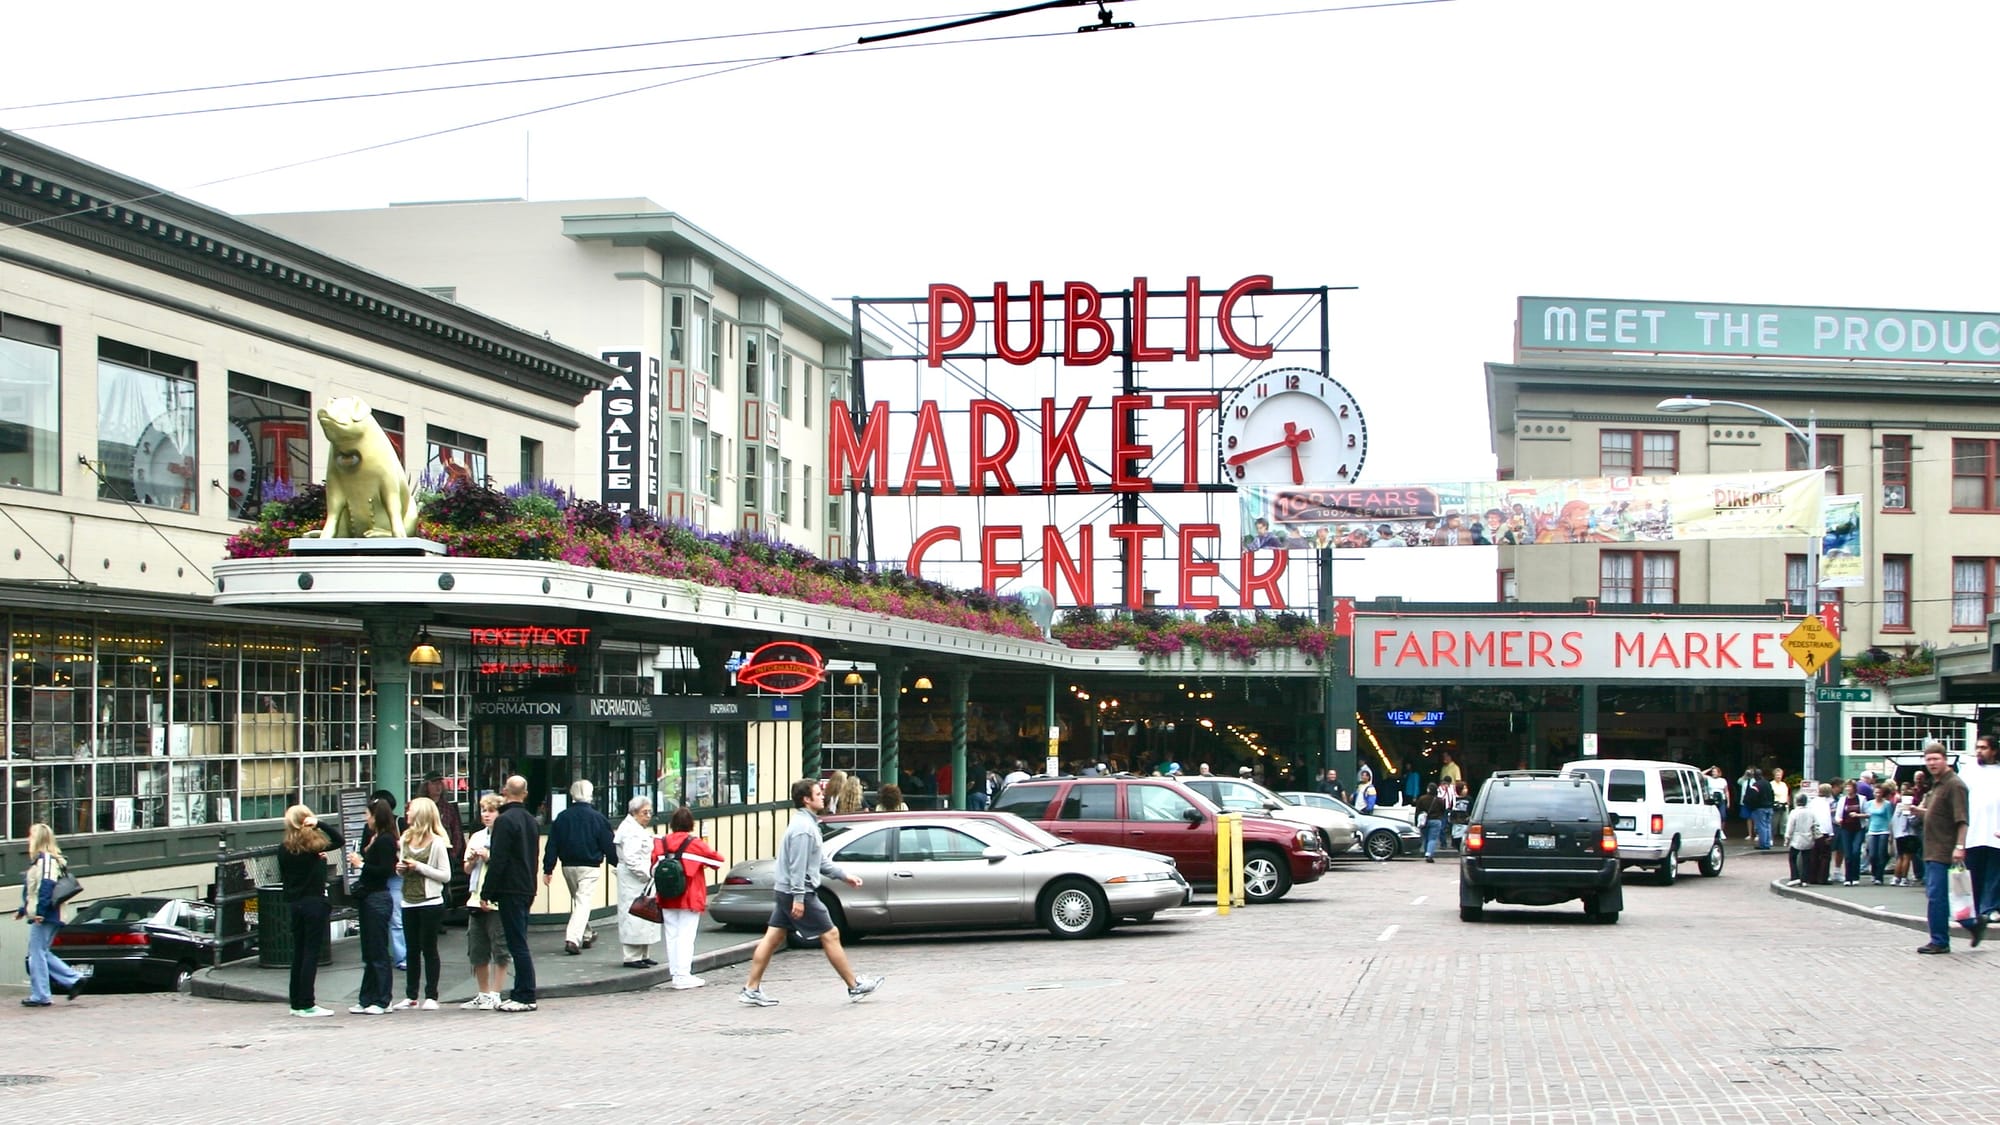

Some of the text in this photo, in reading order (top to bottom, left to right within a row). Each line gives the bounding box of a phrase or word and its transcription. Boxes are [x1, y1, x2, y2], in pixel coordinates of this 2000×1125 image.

[928, 274, 1274, 368] PUBLIC
[1543, 305, 2000, 357] MEET THE PRODUC
[1285, 375, 1300, 390] 12
[1320, 382, 1325, 397] 1
[1257, 383, 1268, 398] 11
[1235, 405, 1249, 420] 10
[1339, 404, 1349, 418] 2
[606, 398, 634, 490] SALLE
[828, 395, 1220, 497] MARKET
[1227, 435, 1238, 449] 9
[1347, 433, 1356, 448] 3
[1235, 465, 1246, 479] 8
[1336, 463, 1349, 478] 4
[1330, 490, 1420, 508] YEARS
[1714, 488, 1750, 508] PIKE
[905, 523, 1290, 611] CENTER
[1801, 624, 1822, 632] YIELD
[1807, 632, 1816, 640] TO
[1372, 629, 1585, 669] FARMERS
[1788, 640, 1834, 649] PEDESTRIANS
[1820, 688, 1842, 700] Pike
[590, 699, 642, 716] INFORMATION
